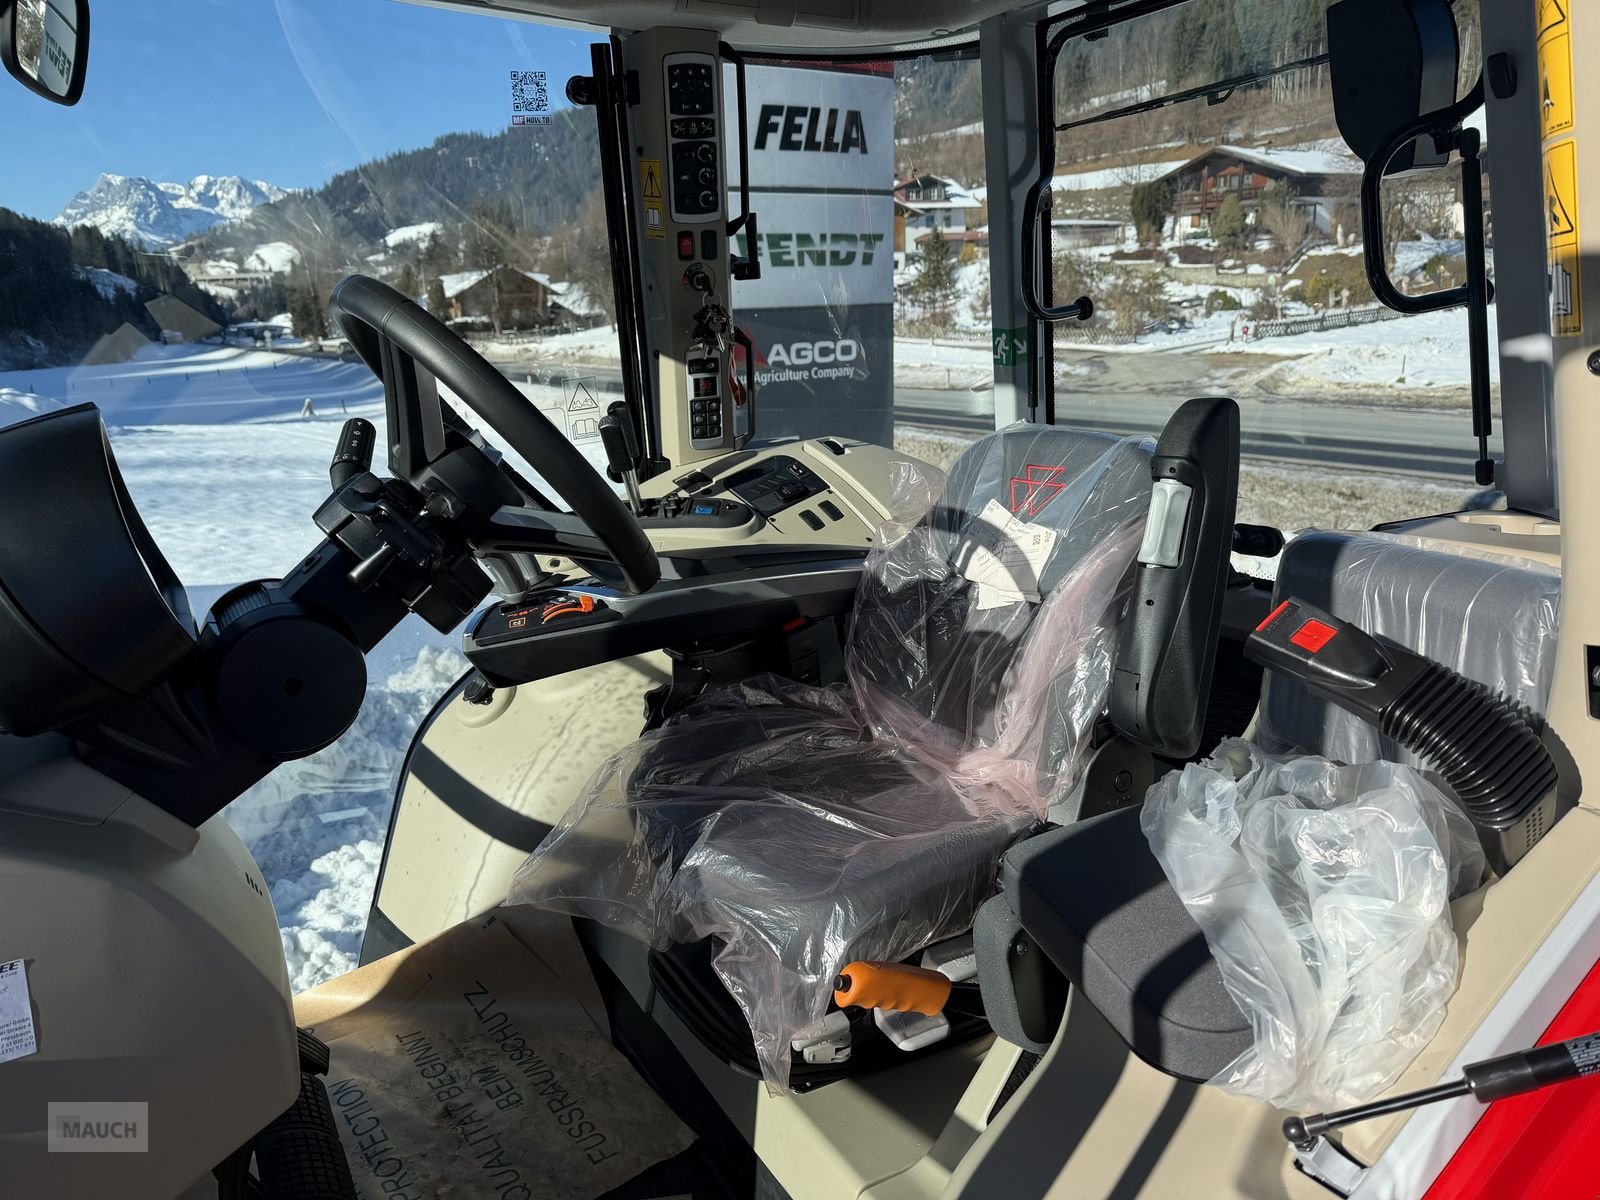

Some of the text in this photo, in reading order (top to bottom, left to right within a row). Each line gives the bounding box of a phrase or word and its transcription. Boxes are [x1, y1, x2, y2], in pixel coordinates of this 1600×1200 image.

[513, 116, 524, 124] MF
[542, 116, 550, 124] TO
[754, 104, 869, 155] FELLA
[754, 368, 809, 386] Agriculture
[811, 366, 854, 380] Company
[767, 339, 857, 366] AGCO
[396, 1030, 466, 1104] BEGINNT
[463, 980, 619, 1166] FUSSRAUMSCHUTZ
[472, 1065, 524, 1113] BEIM
